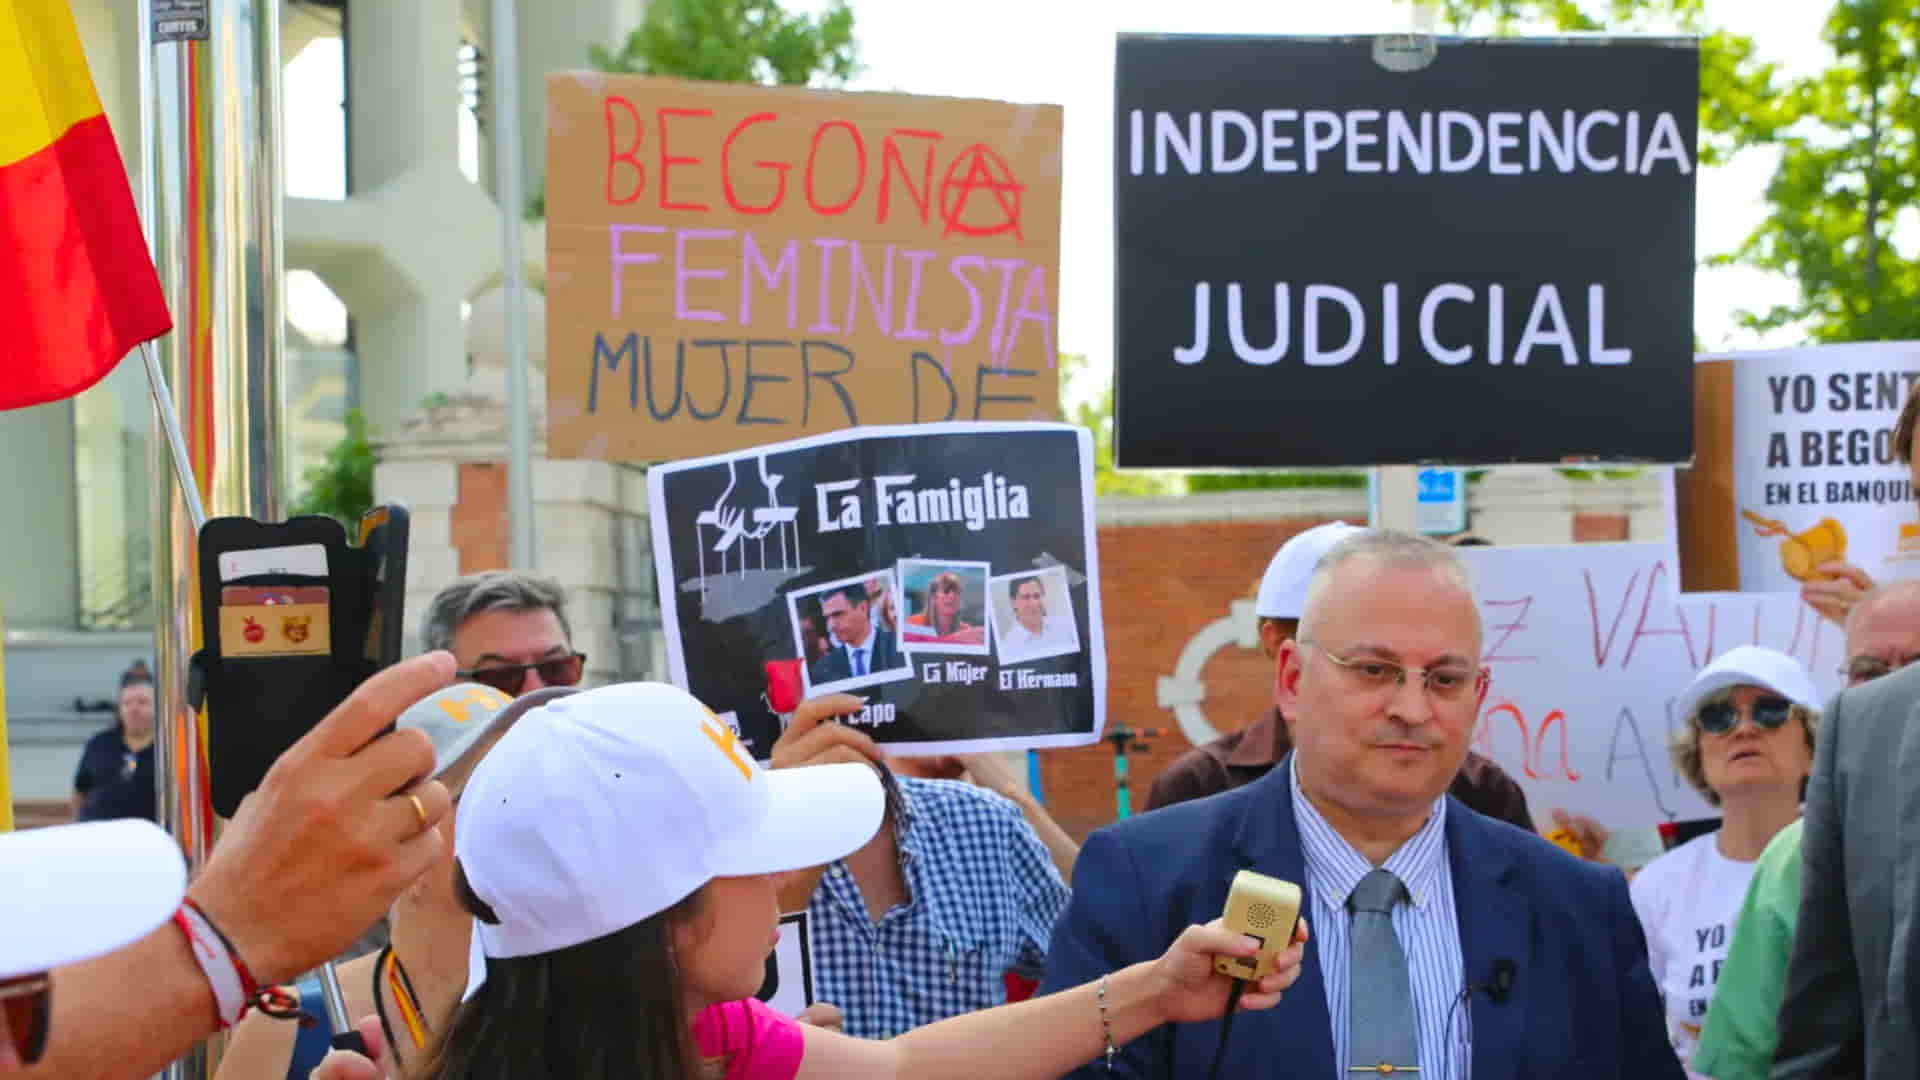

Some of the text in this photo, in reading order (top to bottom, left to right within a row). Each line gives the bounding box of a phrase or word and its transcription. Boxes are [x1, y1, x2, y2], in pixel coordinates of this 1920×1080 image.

[1130, 109, 1692, 176] INDEPENDENCIA
[605, 95, 1027, 246] BEGOÑA
[609, 223, 1057, 378] FEMINISTA
[1173, 282, 1633, 366] JUDICIAL
[587, 331, 1040, 427] MUJER DE
[1768, 373, 1816, 414] YO
[1767, 432, 1791, 469] A
[815, 472, 1030, 533] La Famiglia
[1766, 482, 1791, 505] EN
[1798, 482, 1819, 504] EL
[945, 661, 988, 686] Mujer
[1017, 669, 1078, 689] Hermano
[1695, 923, 1725, 952] YO
